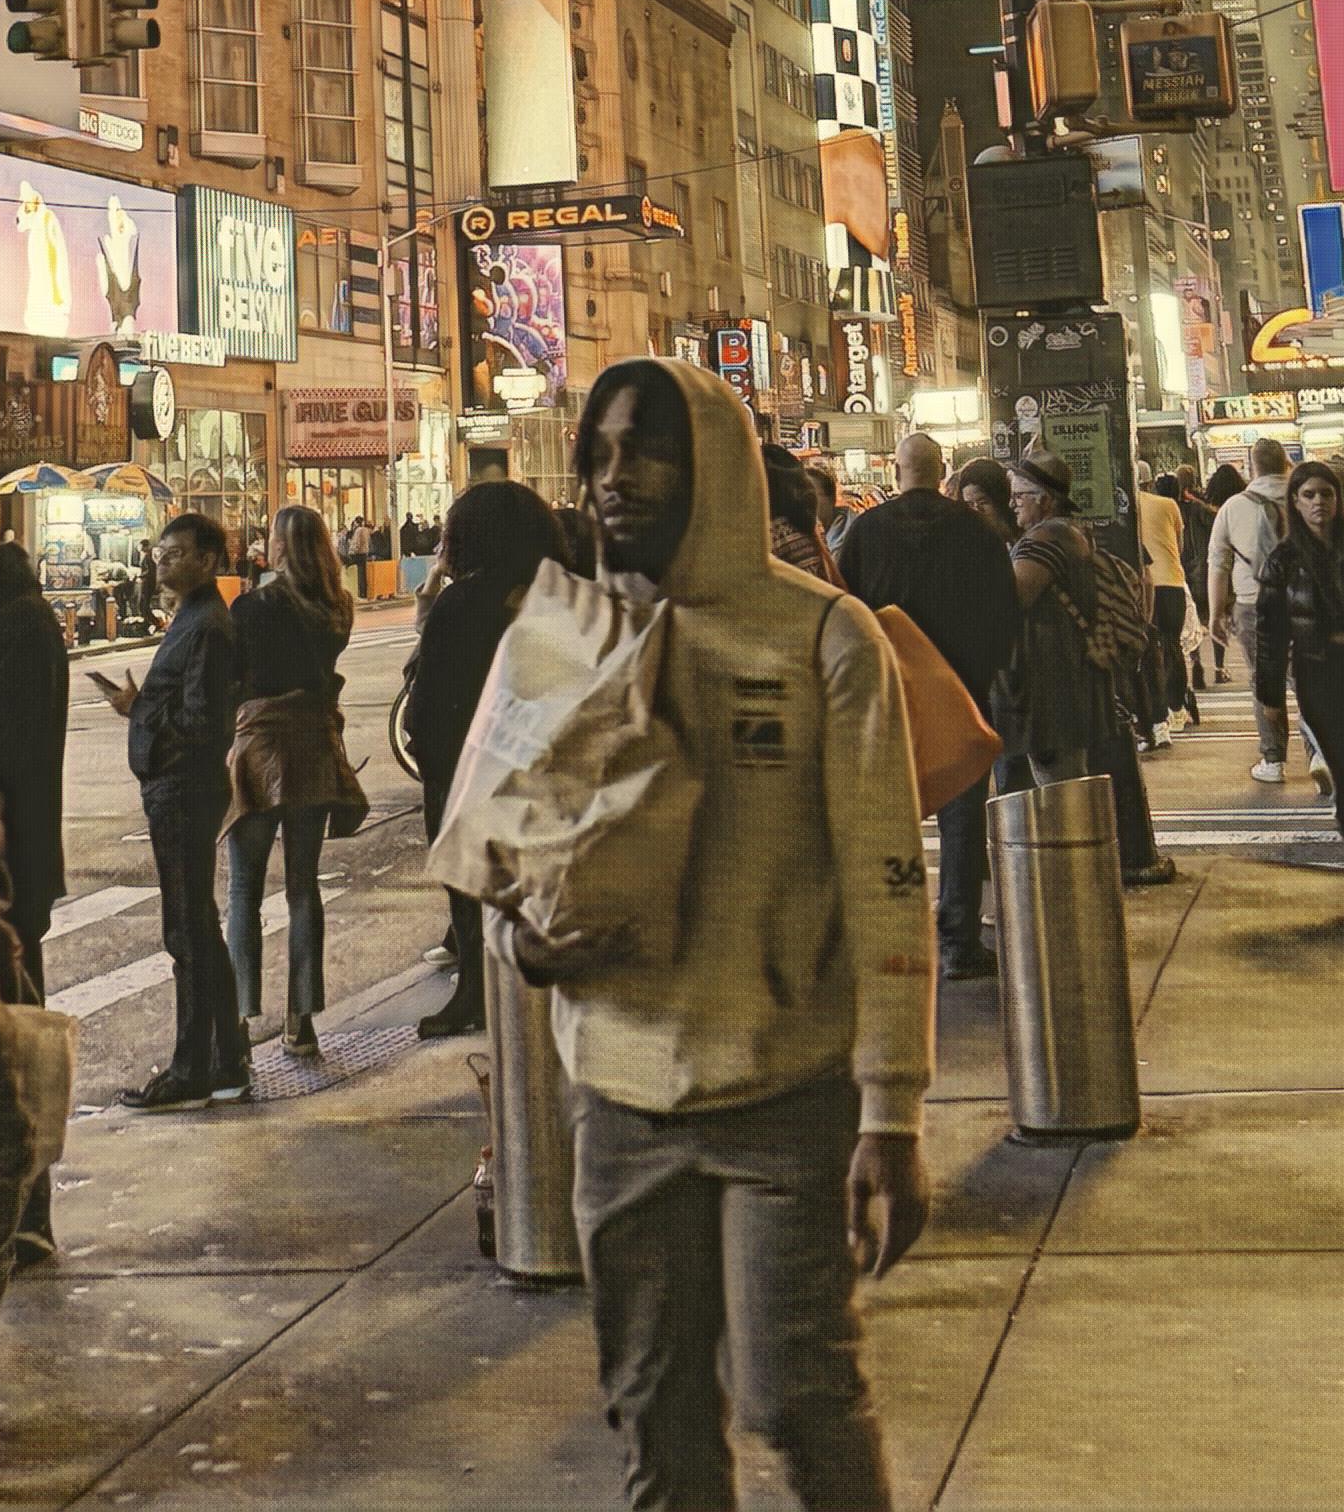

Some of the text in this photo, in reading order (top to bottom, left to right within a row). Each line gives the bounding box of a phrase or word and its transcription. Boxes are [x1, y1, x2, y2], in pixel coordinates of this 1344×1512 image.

[507, 202, 628, 230] REGAL
[218, 283, 286, 336] BELOW
[841, 322, 870, 394] target
